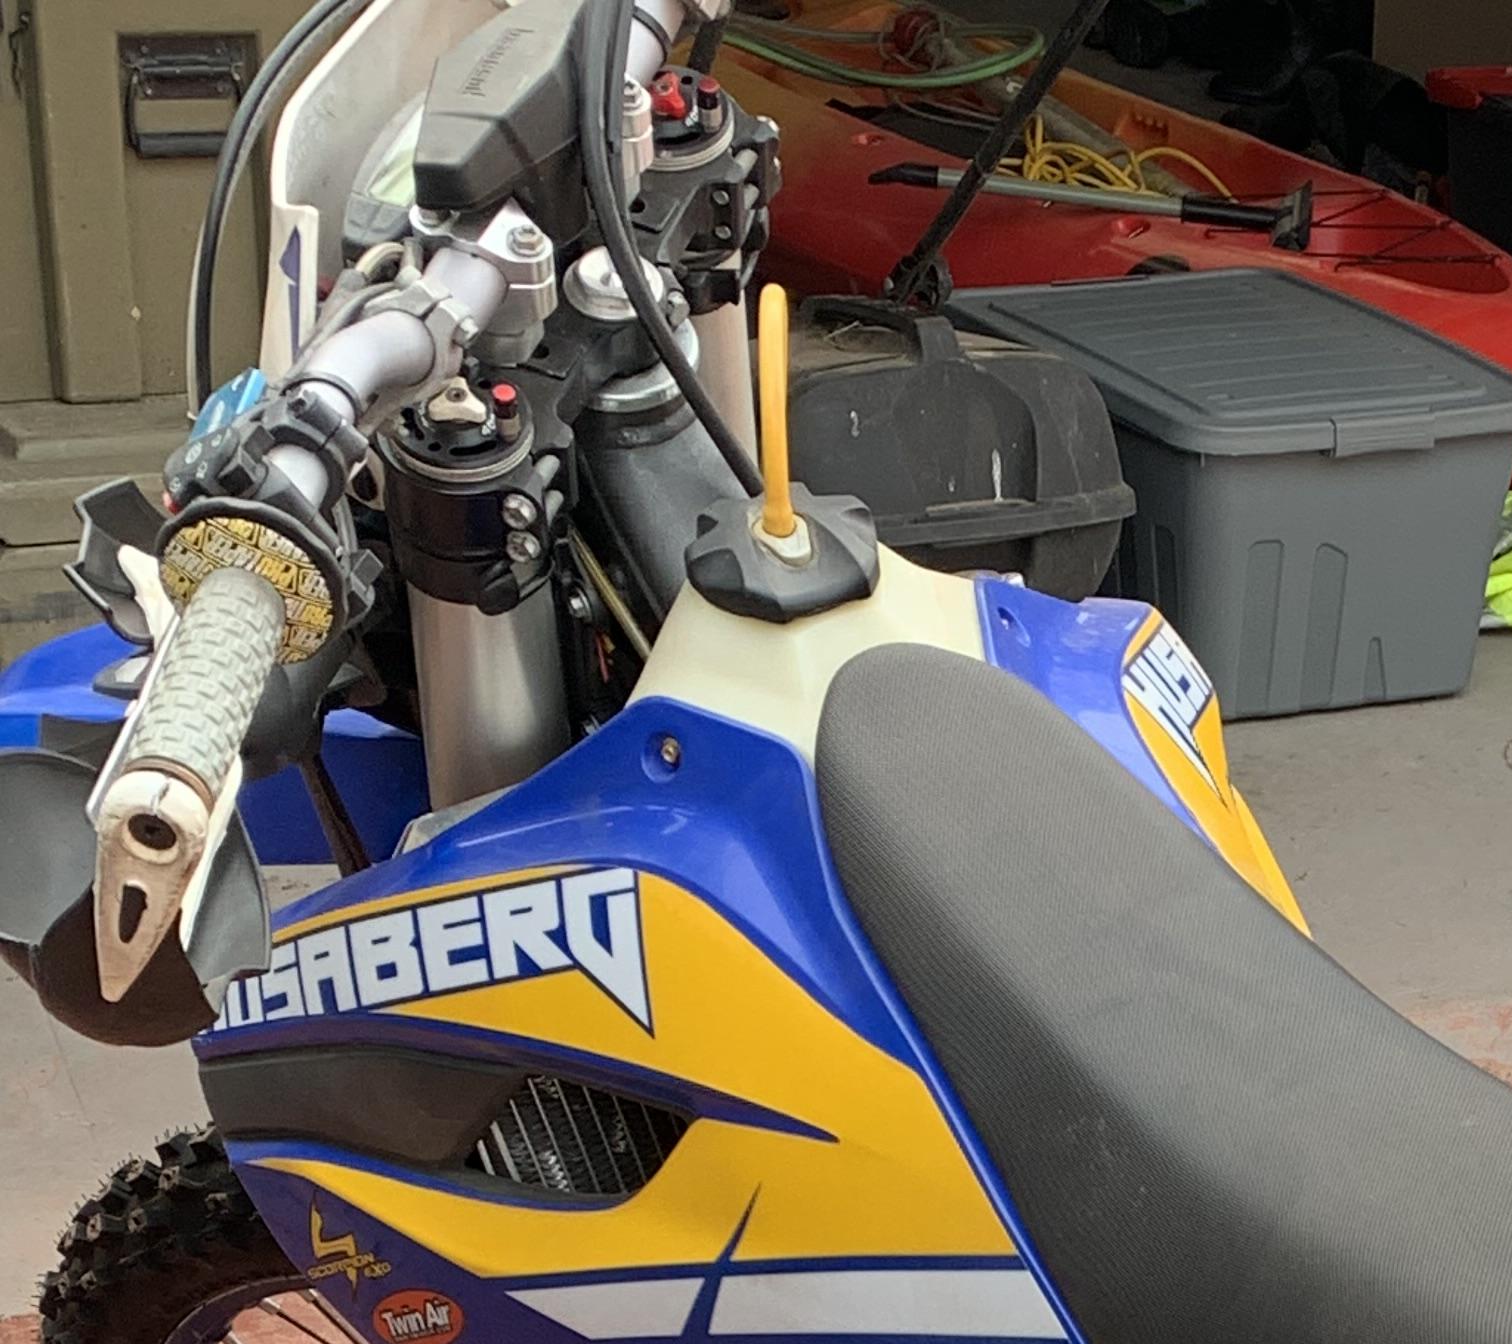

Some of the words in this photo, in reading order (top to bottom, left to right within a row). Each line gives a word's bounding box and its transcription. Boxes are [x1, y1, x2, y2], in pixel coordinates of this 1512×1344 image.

[198, 866, 655, 1038] USABERG
[307, 1251, 376, 1282] SCORPION
[381, 1306, 426, 1338] Twin
[425, 1297, 451, 1329] Air
